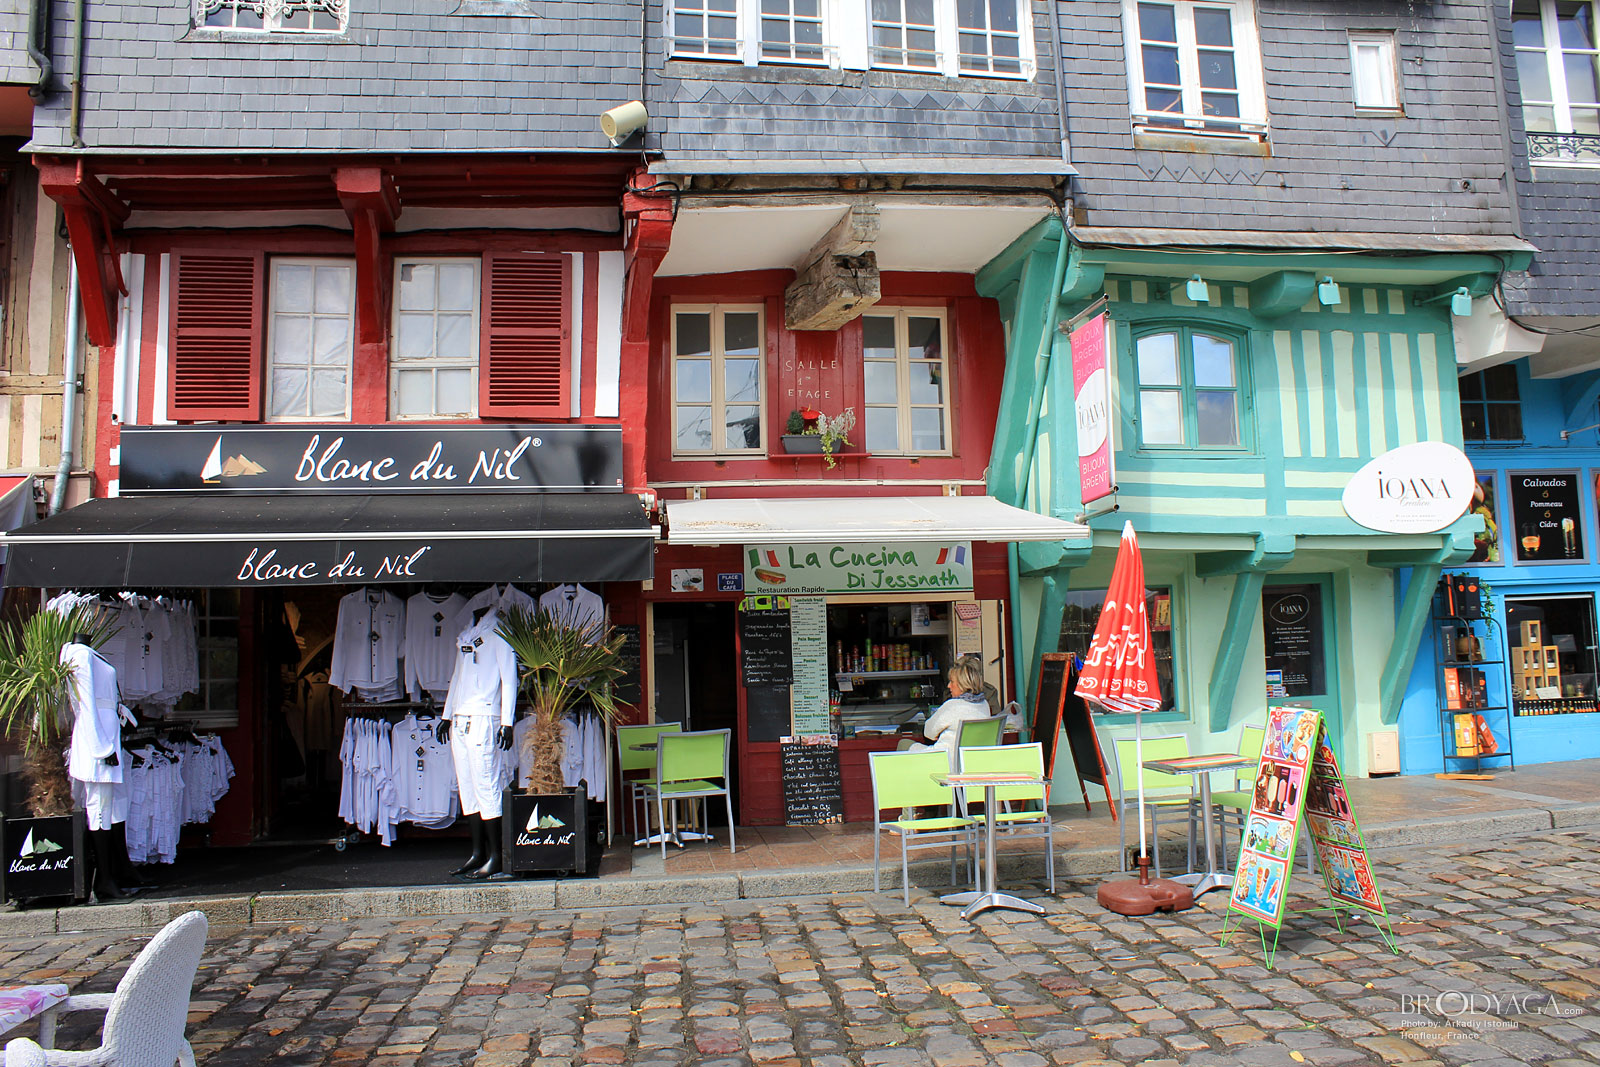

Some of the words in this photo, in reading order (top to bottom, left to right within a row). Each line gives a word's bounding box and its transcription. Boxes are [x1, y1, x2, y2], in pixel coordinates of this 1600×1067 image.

[1074, 325, 1100, 349] BIJOUX
[1074, 338, 1103, 365] ARGENT
[785, 360, 838, 372] SALLE
[788, 389, 831, 399] ETAGE
[294, 434, 400, 482] Blanc
[410, 441, 457, 481] du
[1082, 455, 1106, 475] BIJOUX
[1082, 470, 1108, 490] ARGENT
[1523, 478, 1567, 487] Calvados
[1539, 520, 1558, 528] Cidre
[237, 547, 319, 581] Blanc
[328, 551, 365, 577] du
[788, 546, 821, 569] La
[829, 546, 918, 568] Cucina
[846, 572, 865, 588] Di
[871, 568, 959, 588] Jessnath
[801, 586, 825, 594] Rapide
[542, 833, 555, 845] du
[39, 858, 52, 871] du
